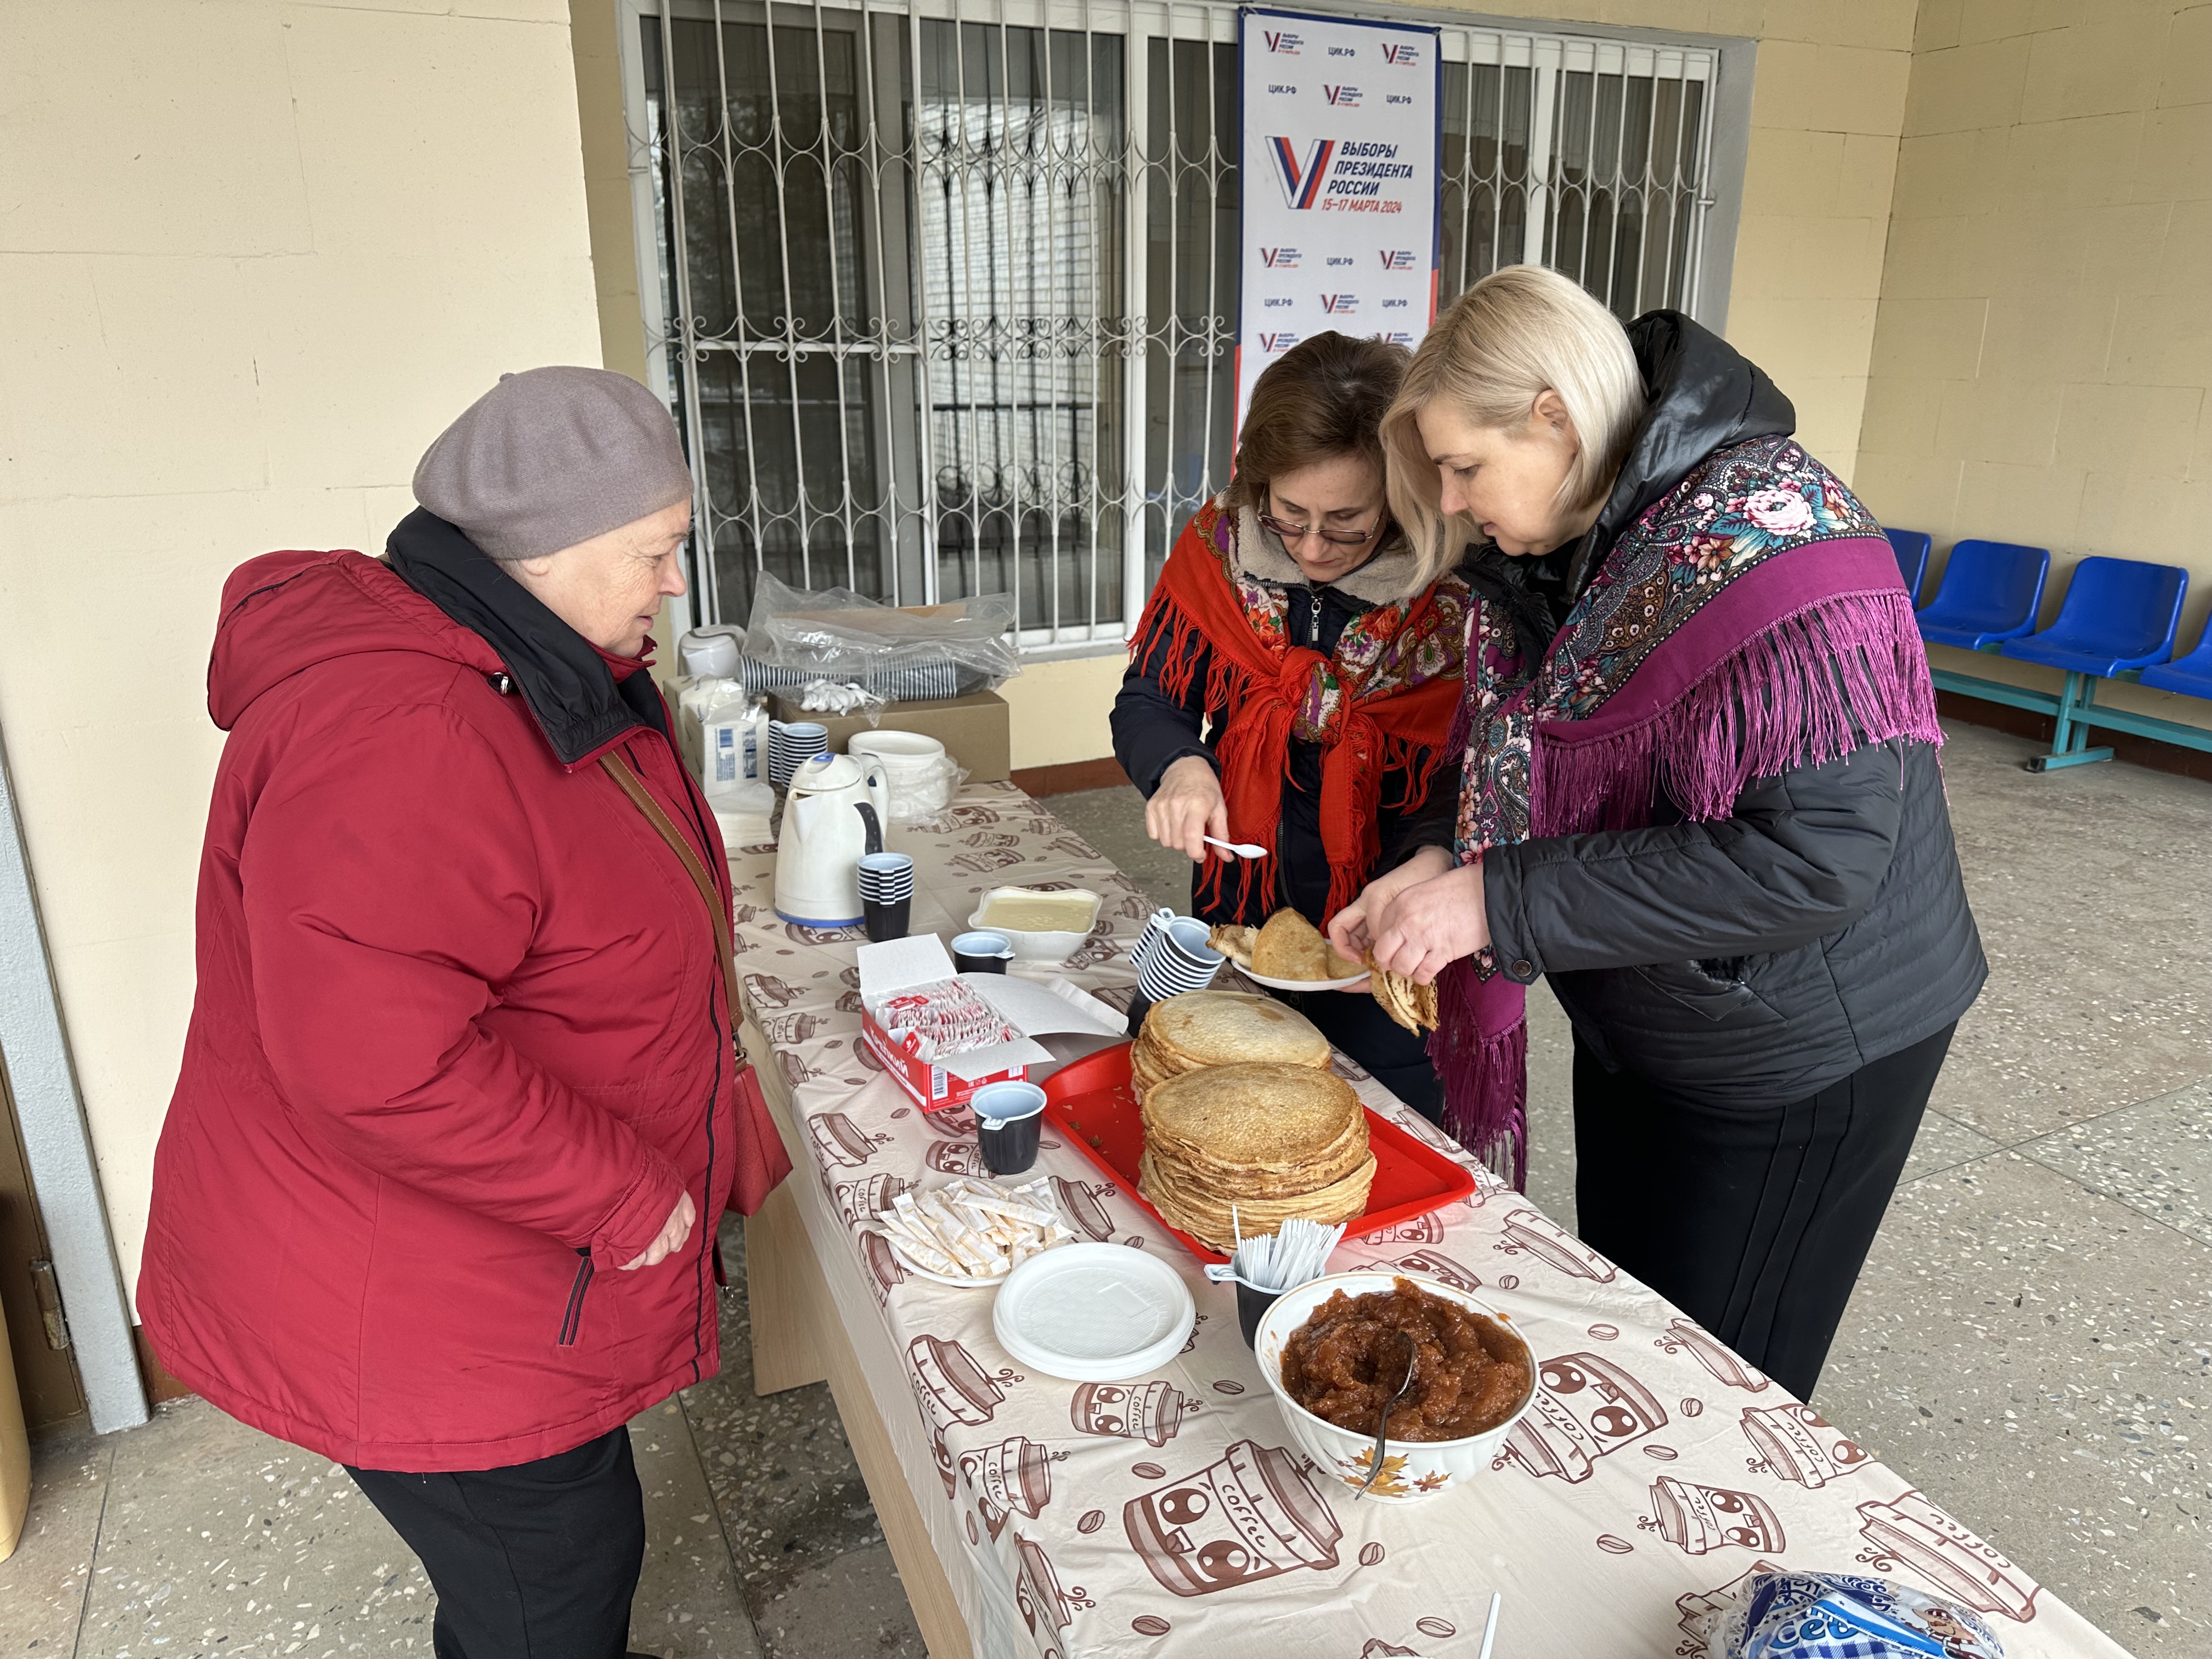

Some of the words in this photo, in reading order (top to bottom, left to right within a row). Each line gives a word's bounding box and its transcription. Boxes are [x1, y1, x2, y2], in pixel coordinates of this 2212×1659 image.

[1328, 47, 1355, 57] ЦИК.РФ
[1268, 84, 1297, 94] ЦИК.РФ
[1386, 94, 1412, 104] ЦИК.РФ
[1340, 141, 1398, 159] ВЫБОРЫ
[1334, 160, 1413, 179] ПРЕЗИДЕНТА
[1327, 179, 1381, 196] РОССИИ
[1348, 200, 1380, 213] МАРТА
[1380, 201, 1403, 214] 2024
[1327, 257, 1353, 267] ЦИК.РФ
[1264, 298, 1293, 308] ЦИК.РФ
[1383, 299, 1408, 308] ЦИК.РФ
[857, 1188, 866, 1212] coffee
[912, 1372, 936, 1415] coffee
[1131, 1395, 1142, 1430] coffee
[1786, 1421, 1824, 1463] coffee
[988, 1462, 1002, 1500] coffee
[1221, 1484, 1266, 1549] coffee
[1695, 1497, 1716, 1531] coffee
[1929, 1513, 2011, 1568] coffee
